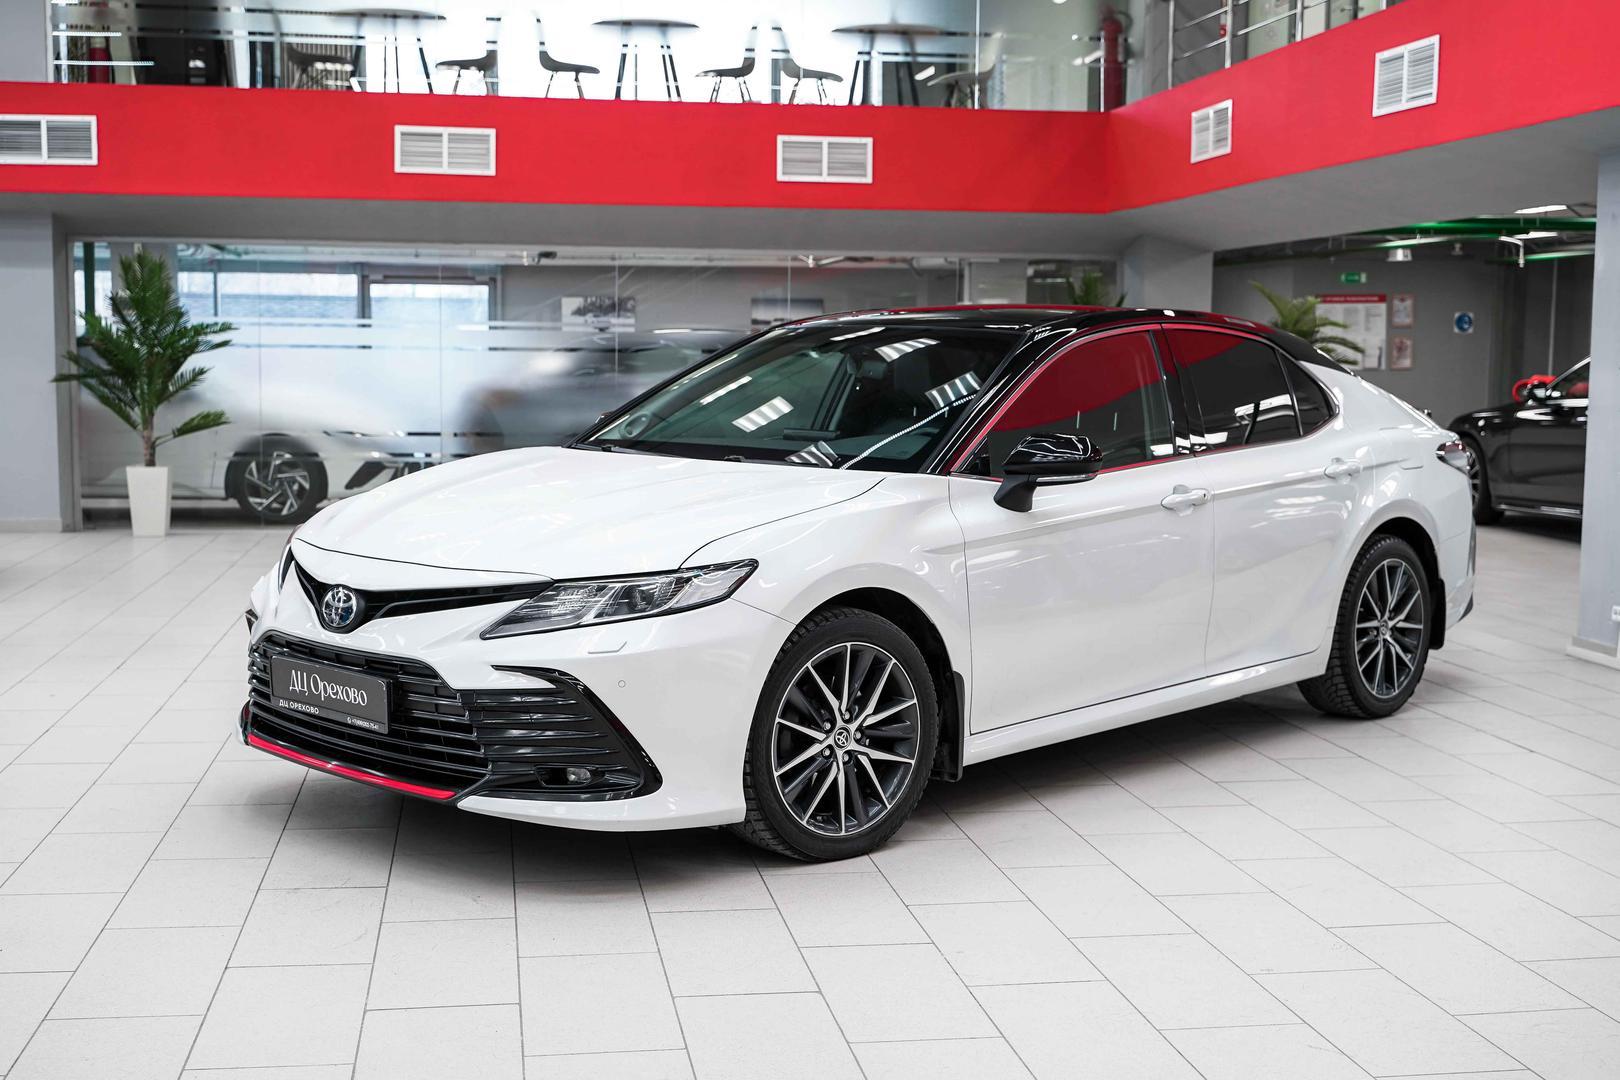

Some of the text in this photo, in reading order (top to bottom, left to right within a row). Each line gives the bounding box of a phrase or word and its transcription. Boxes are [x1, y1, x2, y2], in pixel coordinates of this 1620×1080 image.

[290, 669, 368, 706] ДЦ Орехово
[279, 699, 319, 715] ДЦ ОРЕХОВО
